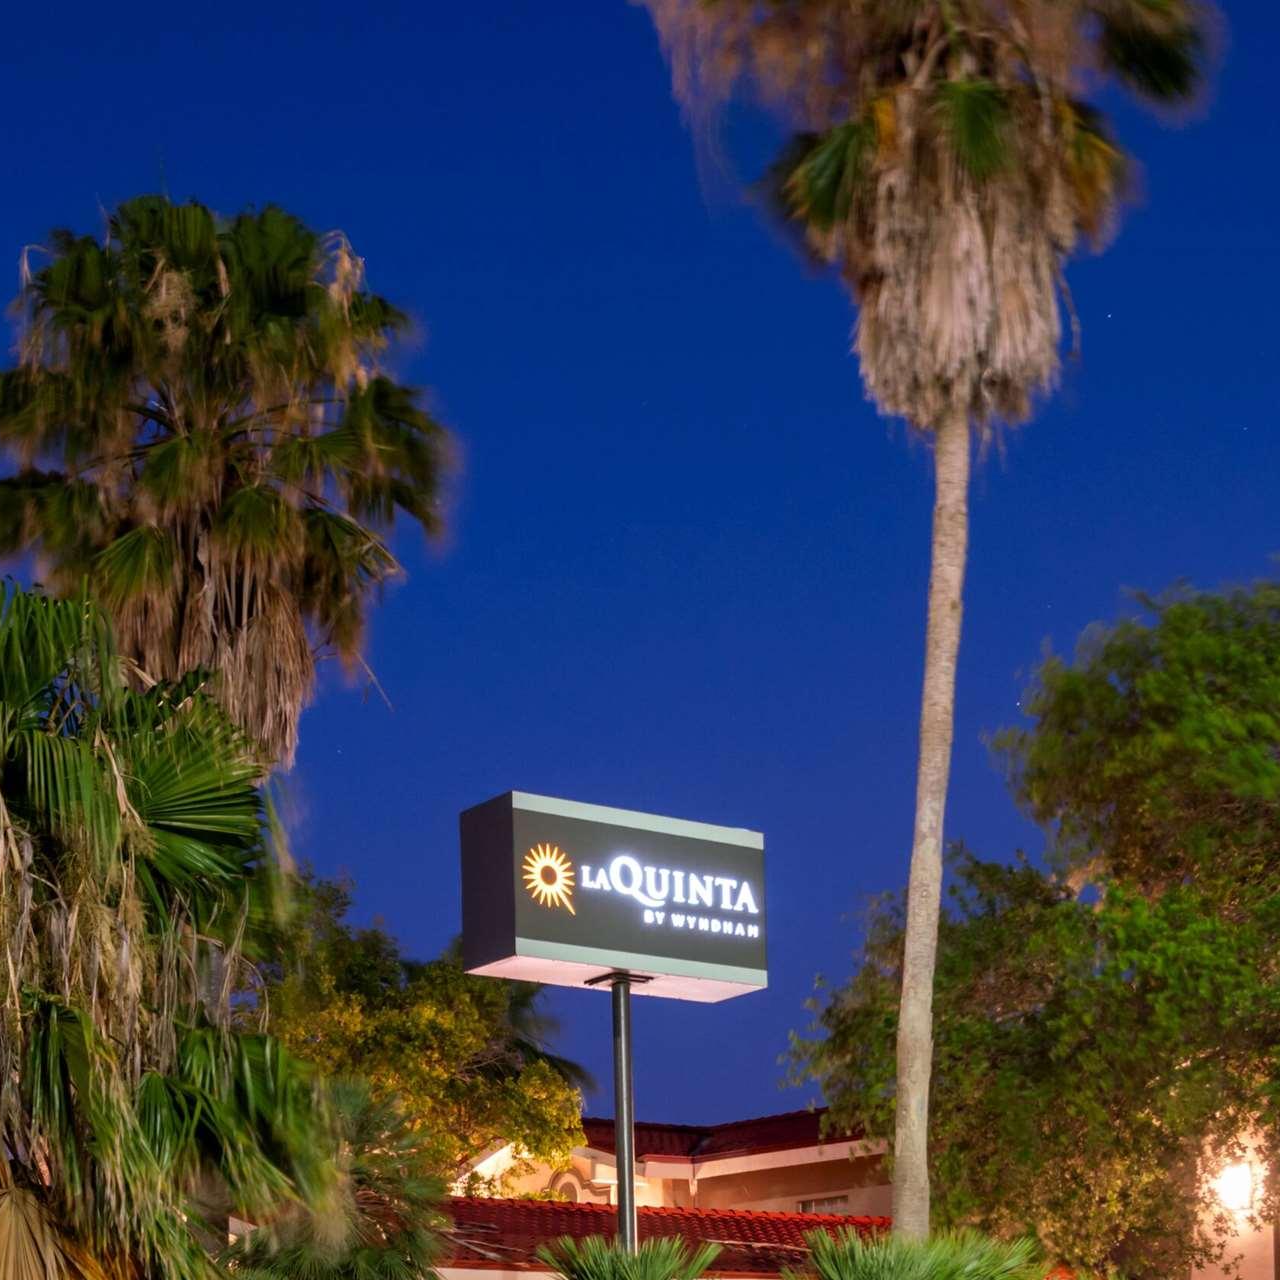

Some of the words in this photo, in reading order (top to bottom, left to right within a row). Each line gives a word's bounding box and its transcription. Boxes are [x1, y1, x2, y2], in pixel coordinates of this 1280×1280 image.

[609, 855, 759, 914] QUINTA
[643, 909, 666, 925] BY
[671, 913, 759, 938] WYNDHAM
